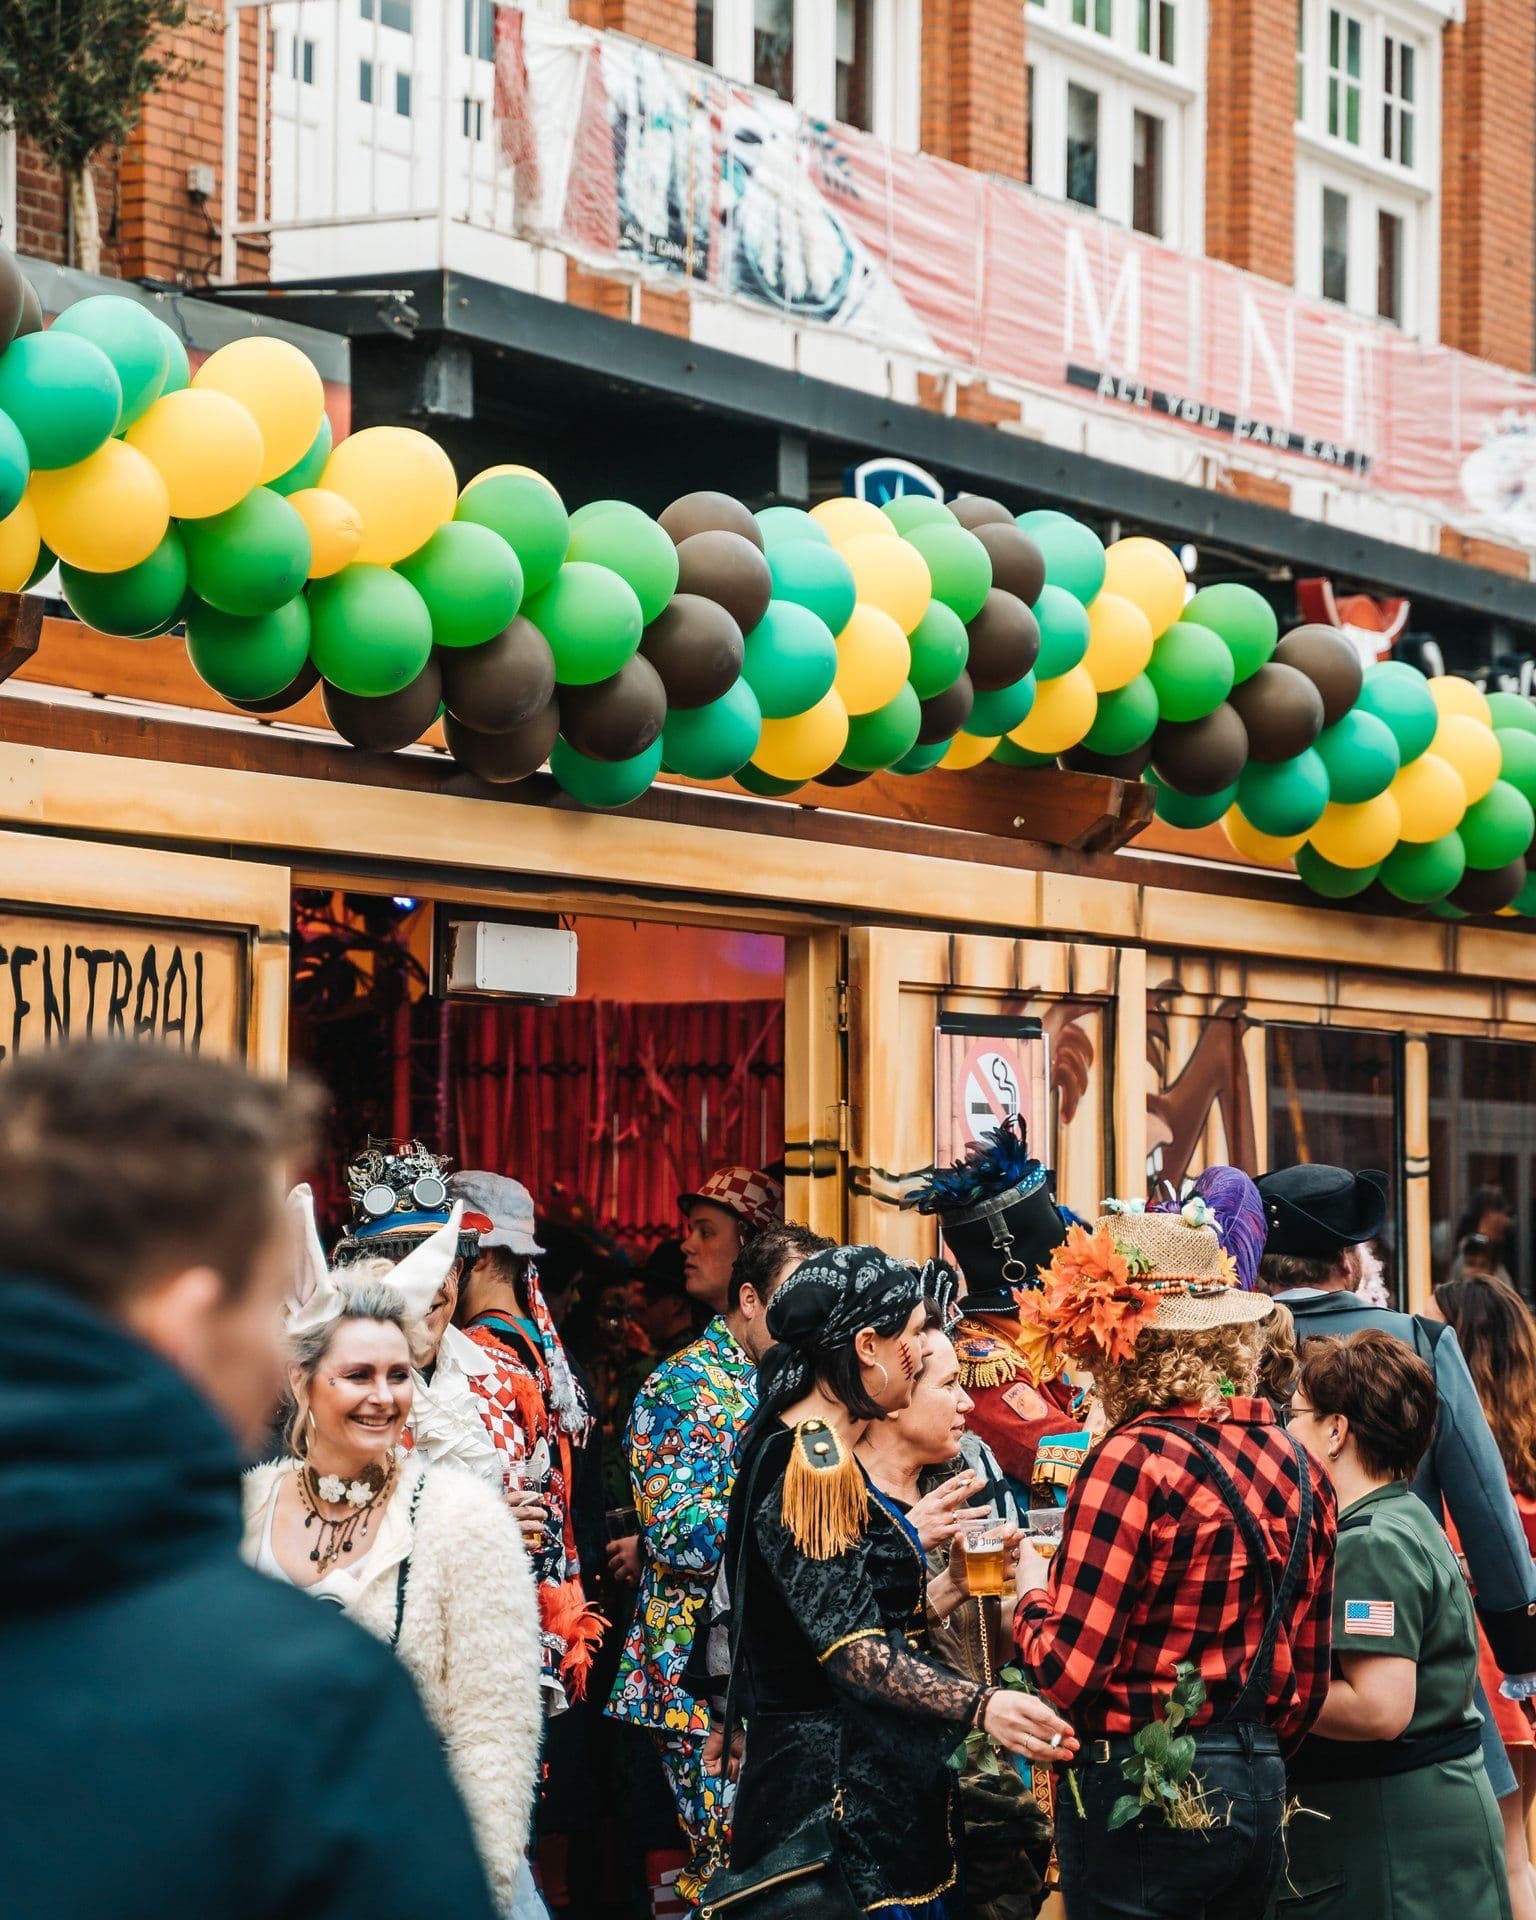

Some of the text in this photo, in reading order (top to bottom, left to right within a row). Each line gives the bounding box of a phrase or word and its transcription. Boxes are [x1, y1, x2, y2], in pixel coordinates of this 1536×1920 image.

[1064, 228, 1384, 446] MINT
[1097, 374, 1347, 466] ALL YOU CAN EAT
